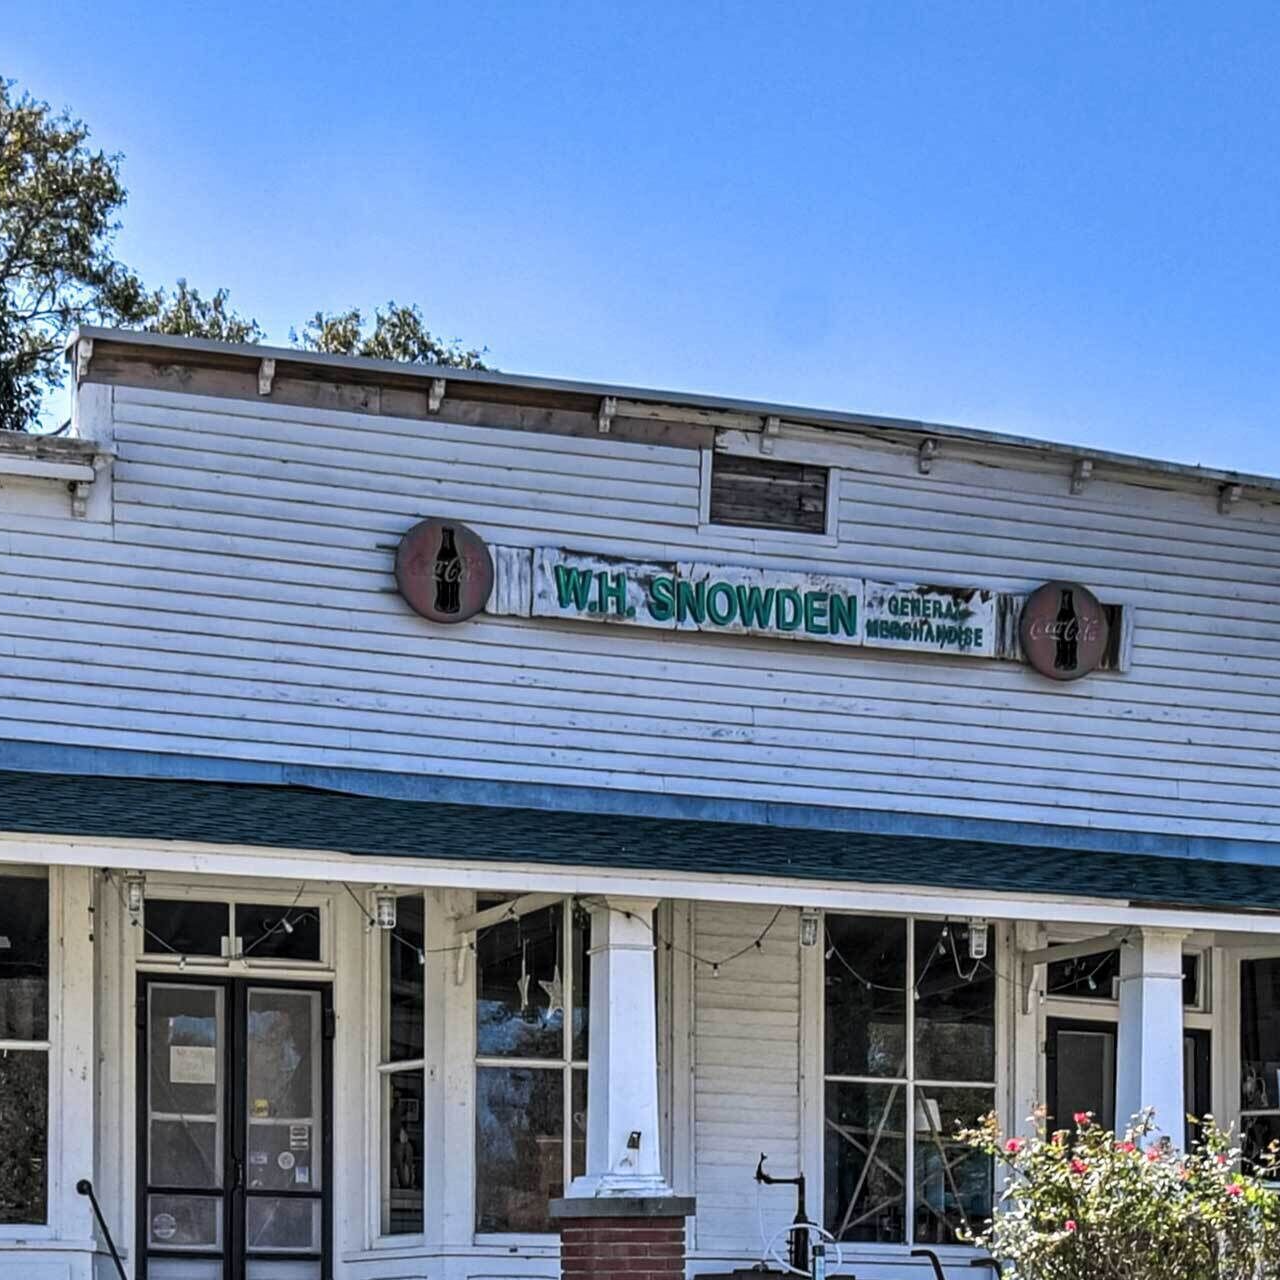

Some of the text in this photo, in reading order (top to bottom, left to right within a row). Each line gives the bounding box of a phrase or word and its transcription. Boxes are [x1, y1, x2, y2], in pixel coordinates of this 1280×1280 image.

[554, 564, 858, 638] W.H. SNOWDEN
[866, 617, 984, 648] MERCHANDISE
